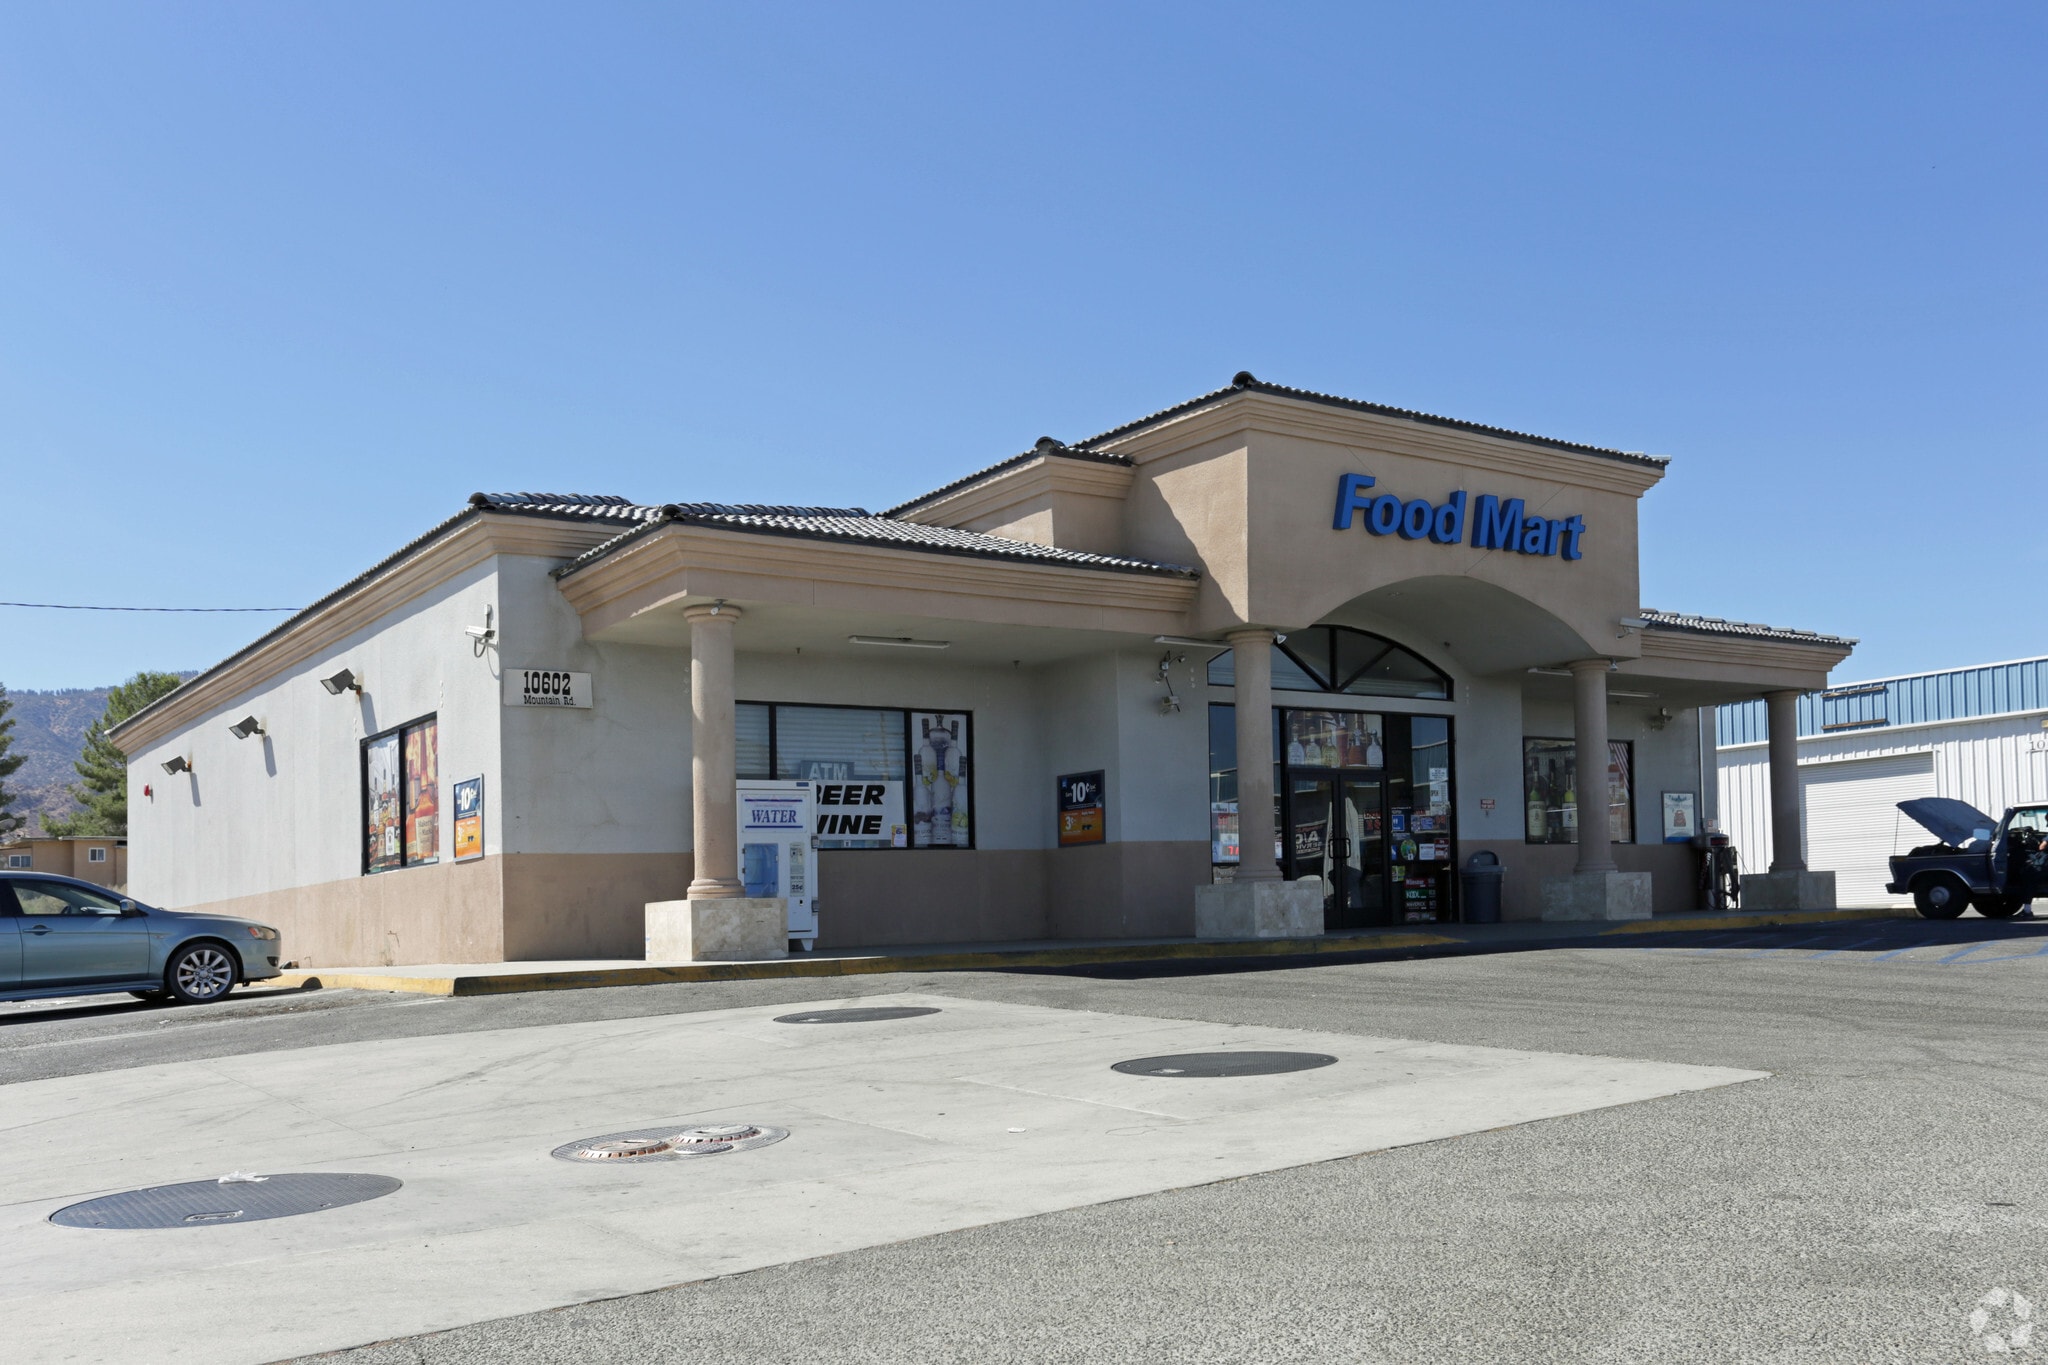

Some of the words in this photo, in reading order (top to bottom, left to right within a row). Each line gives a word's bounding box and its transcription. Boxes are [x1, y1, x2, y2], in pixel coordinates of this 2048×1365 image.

[1333, 473, 1467, 544] Food
[1471, 494, 1585, 561] Mart
[524, 671, 570, 695] 10602
[524, 695, 560, 705] Mountain
[564, 696, 576, 706] Rd.
[809, 762, 848, 780] ATM
[817, 785, 885, 805] EER
[752, 809, 797, 824] WATER
